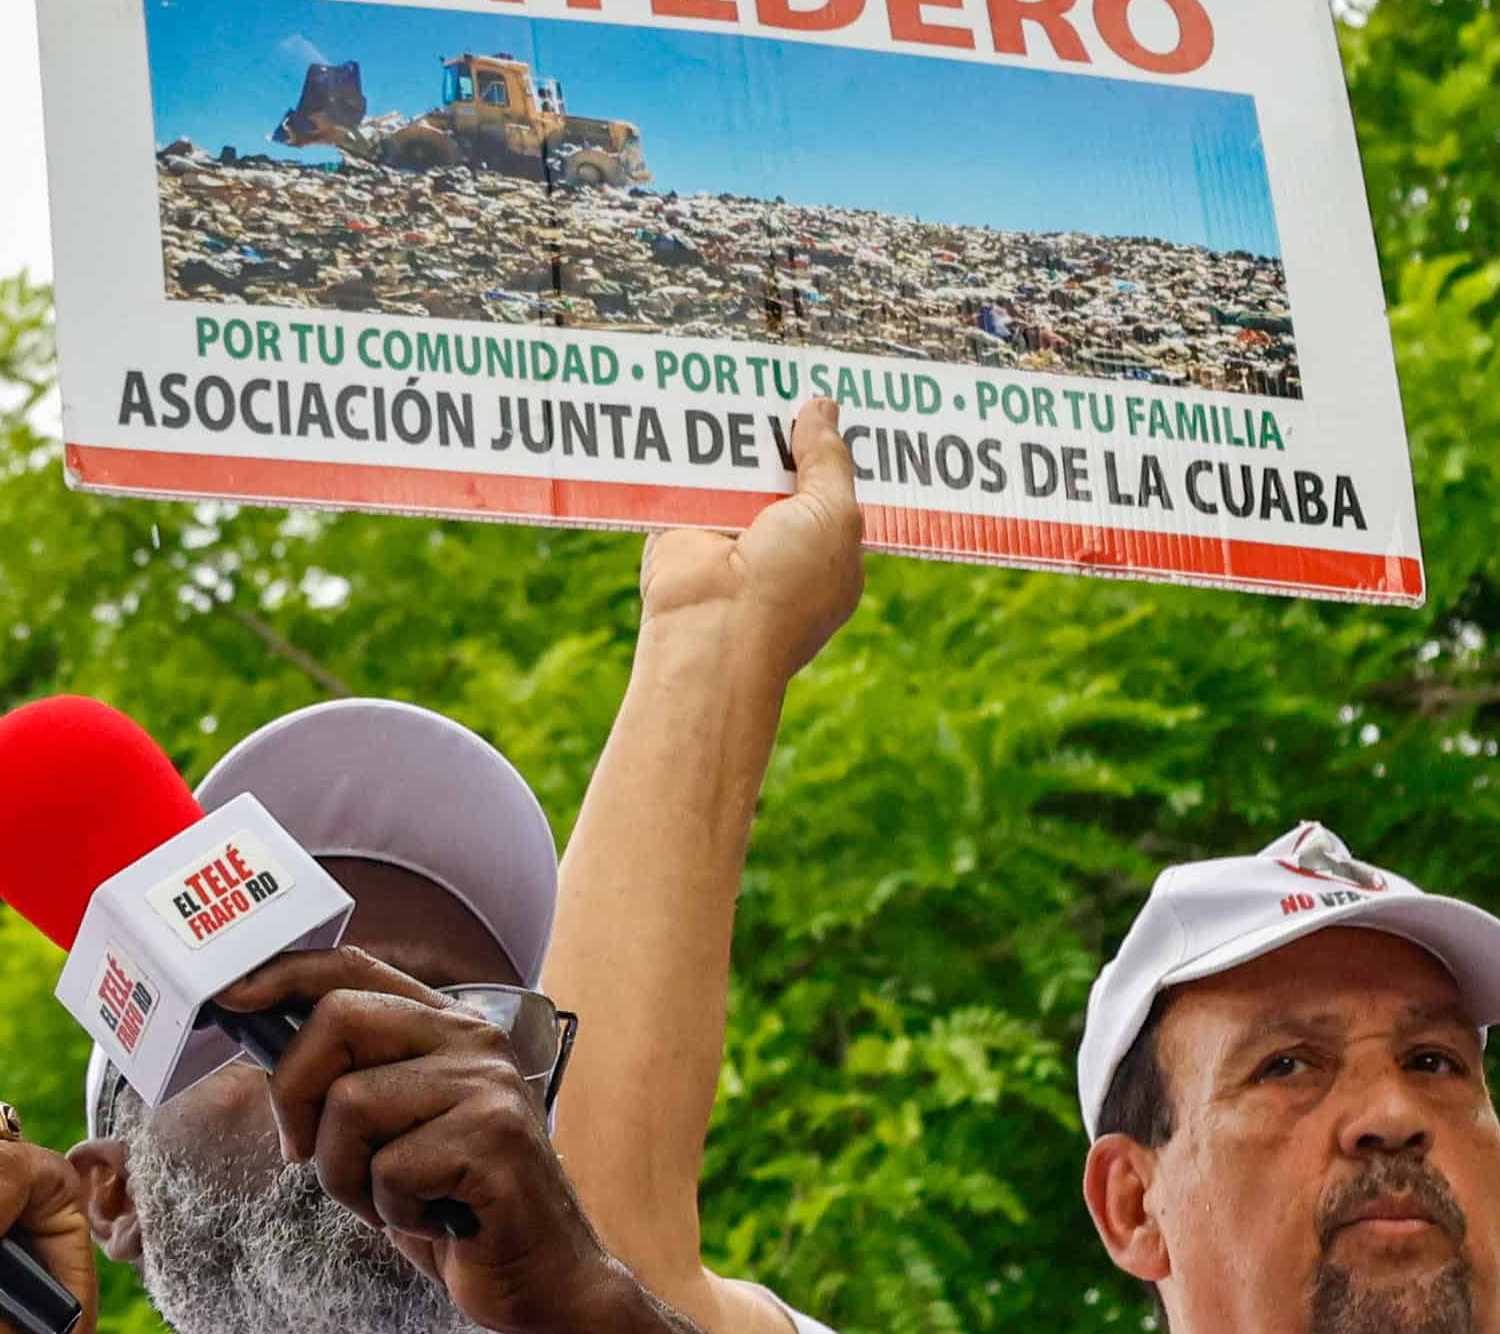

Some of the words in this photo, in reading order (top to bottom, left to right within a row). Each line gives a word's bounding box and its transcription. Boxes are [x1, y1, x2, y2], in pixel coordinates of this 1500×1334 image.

[196, 316, 282, 362] POR
[289, 321, 346, 366] TU
[357, 326, 620, 388] COMUNIDAD
[655, 349, 741, 396] POR
[745, 355, 799, 401] TU
[808, 362, 943, 416] SALUD
[974, 380, 1059, 427] POR
[1062, 390, 1117, 434] TU
[1125, 396, 1286, 451] FAMILIA
[117, 367, 477, 450] ASOCIACIÓN
[490, 395, 673, 463] JUNTA
[684, 409, 760, 469] DE
[766, 414, 1008, 494] VCINOS
[1019, 441, 1093, 502] DE
[1103, 450, 1175, 512] LA
[1183, 458, 1370, 532] CUABA
[172, 891, 202, 919] EL
[184, 842, 255, 906] TELÉ
[187, 889, 251, 940] FRAFO
[244, 870, 279, 903] RD
[98, 952, 134, 1019] TELÉ
[99, 1002, 119, 1032] EL
[131, 980, 153, 1016] RD
